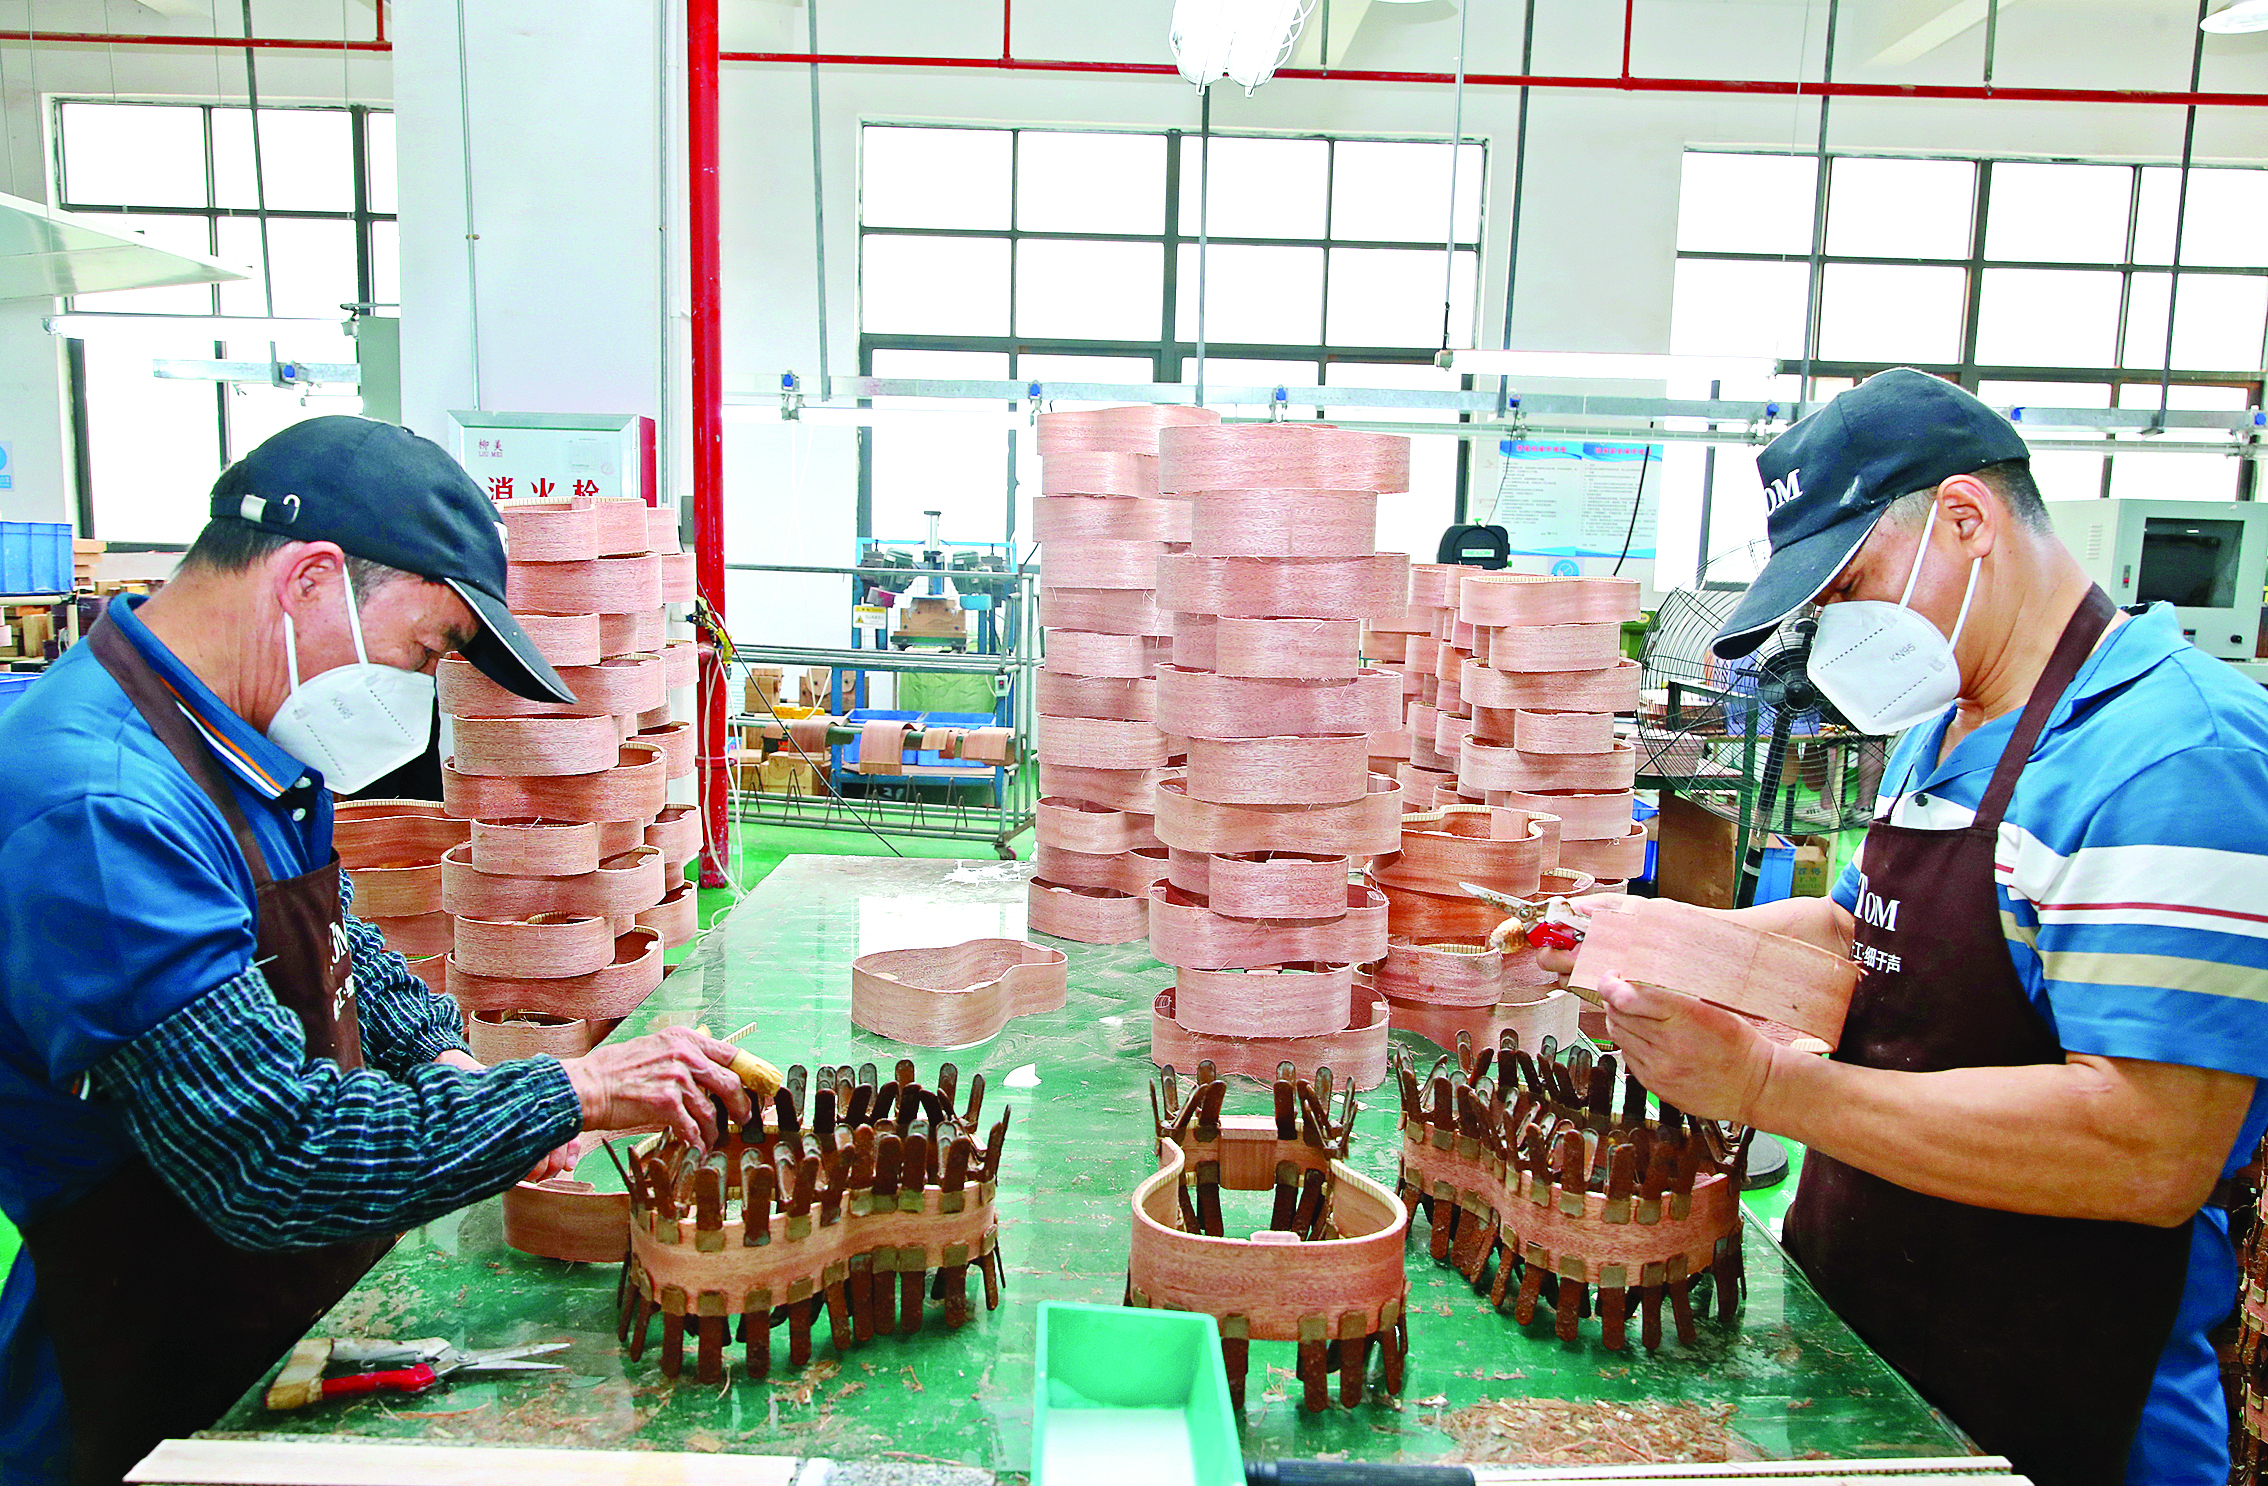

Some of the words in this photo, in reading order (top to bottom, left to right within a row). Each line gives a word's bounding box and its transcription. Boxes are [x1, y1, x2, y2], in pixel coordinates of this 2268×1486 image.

[1888, 642, 1916, 664] KN95
[330, 696, 354, 720] KN95
[1853, 872, 1900, 932] TOM
